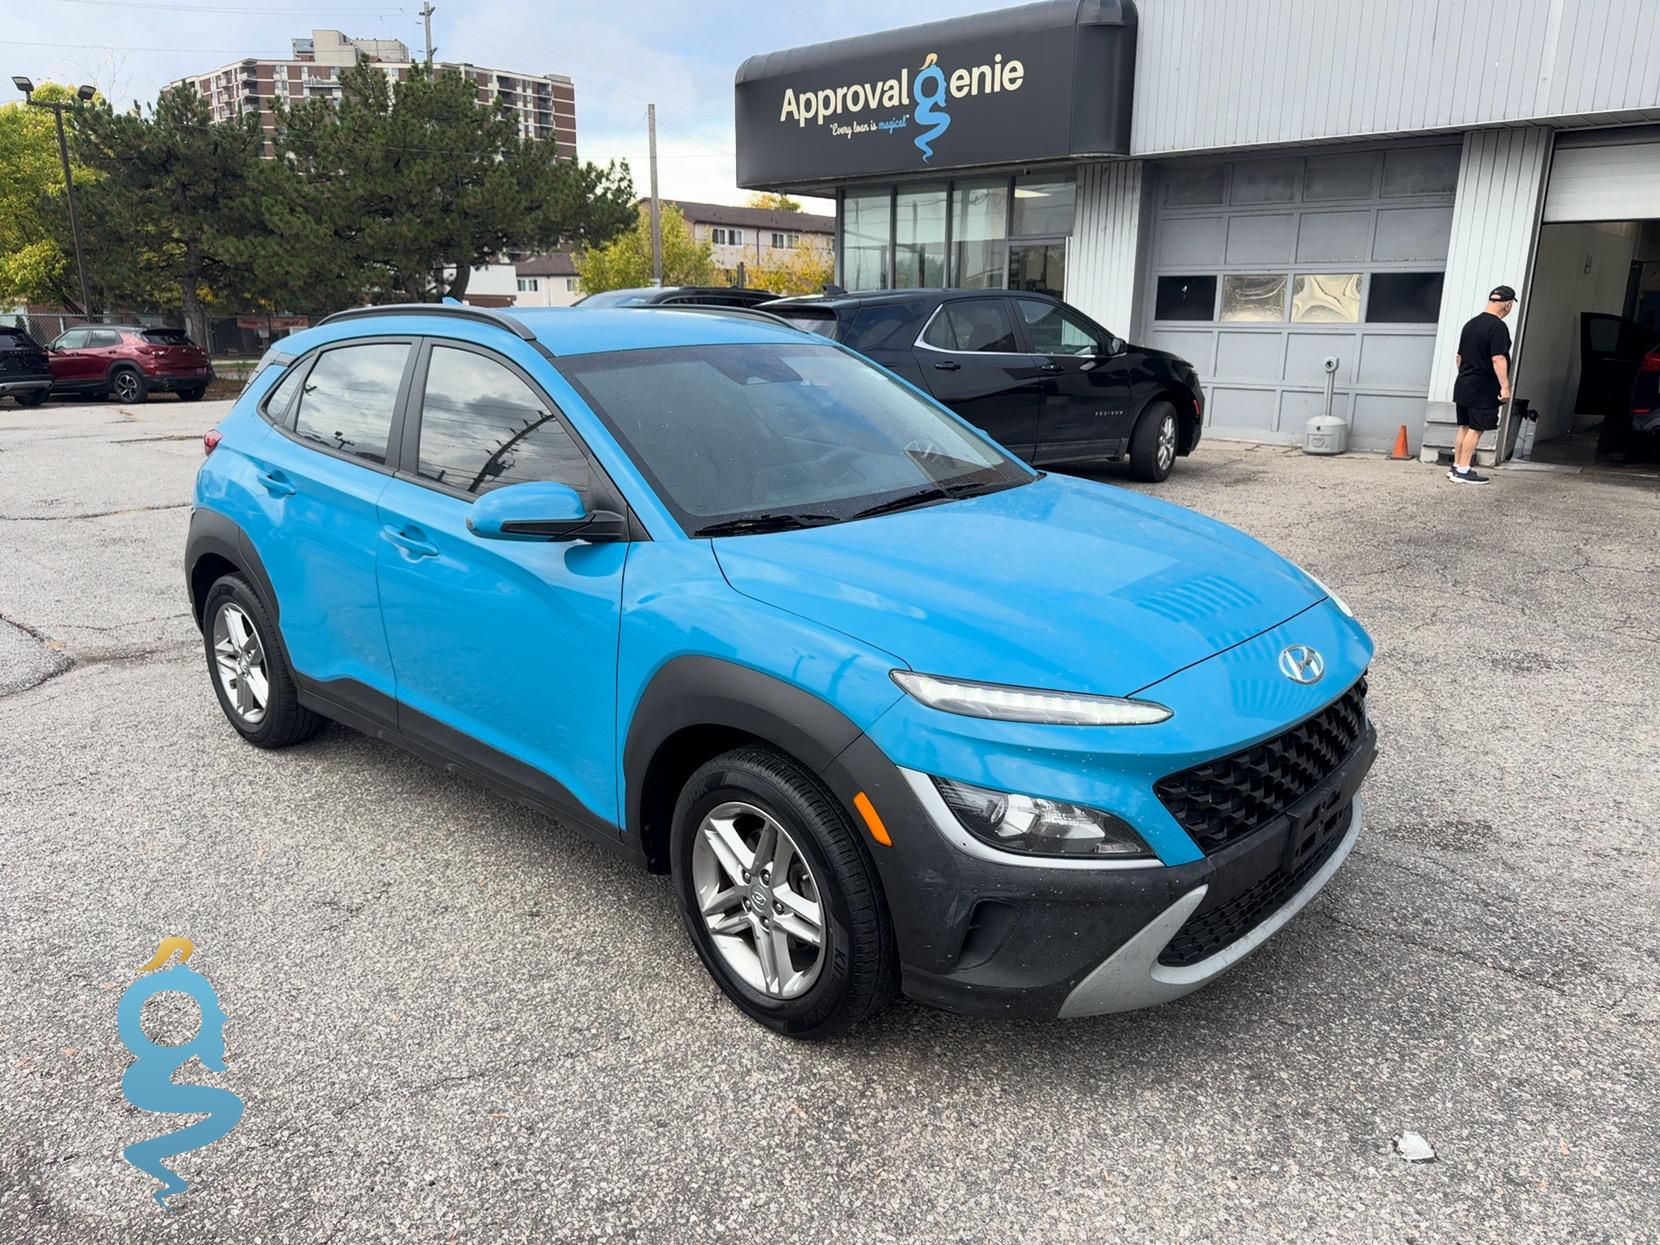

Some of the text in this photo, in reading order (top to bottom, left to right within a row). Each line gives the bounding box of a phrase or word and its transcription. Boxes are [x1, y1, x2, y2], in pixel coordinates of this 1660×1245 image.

[780, 68, 910, 127] Approval
[853, 120, 870, 133] loan
[870, 120, 878, 131] is
